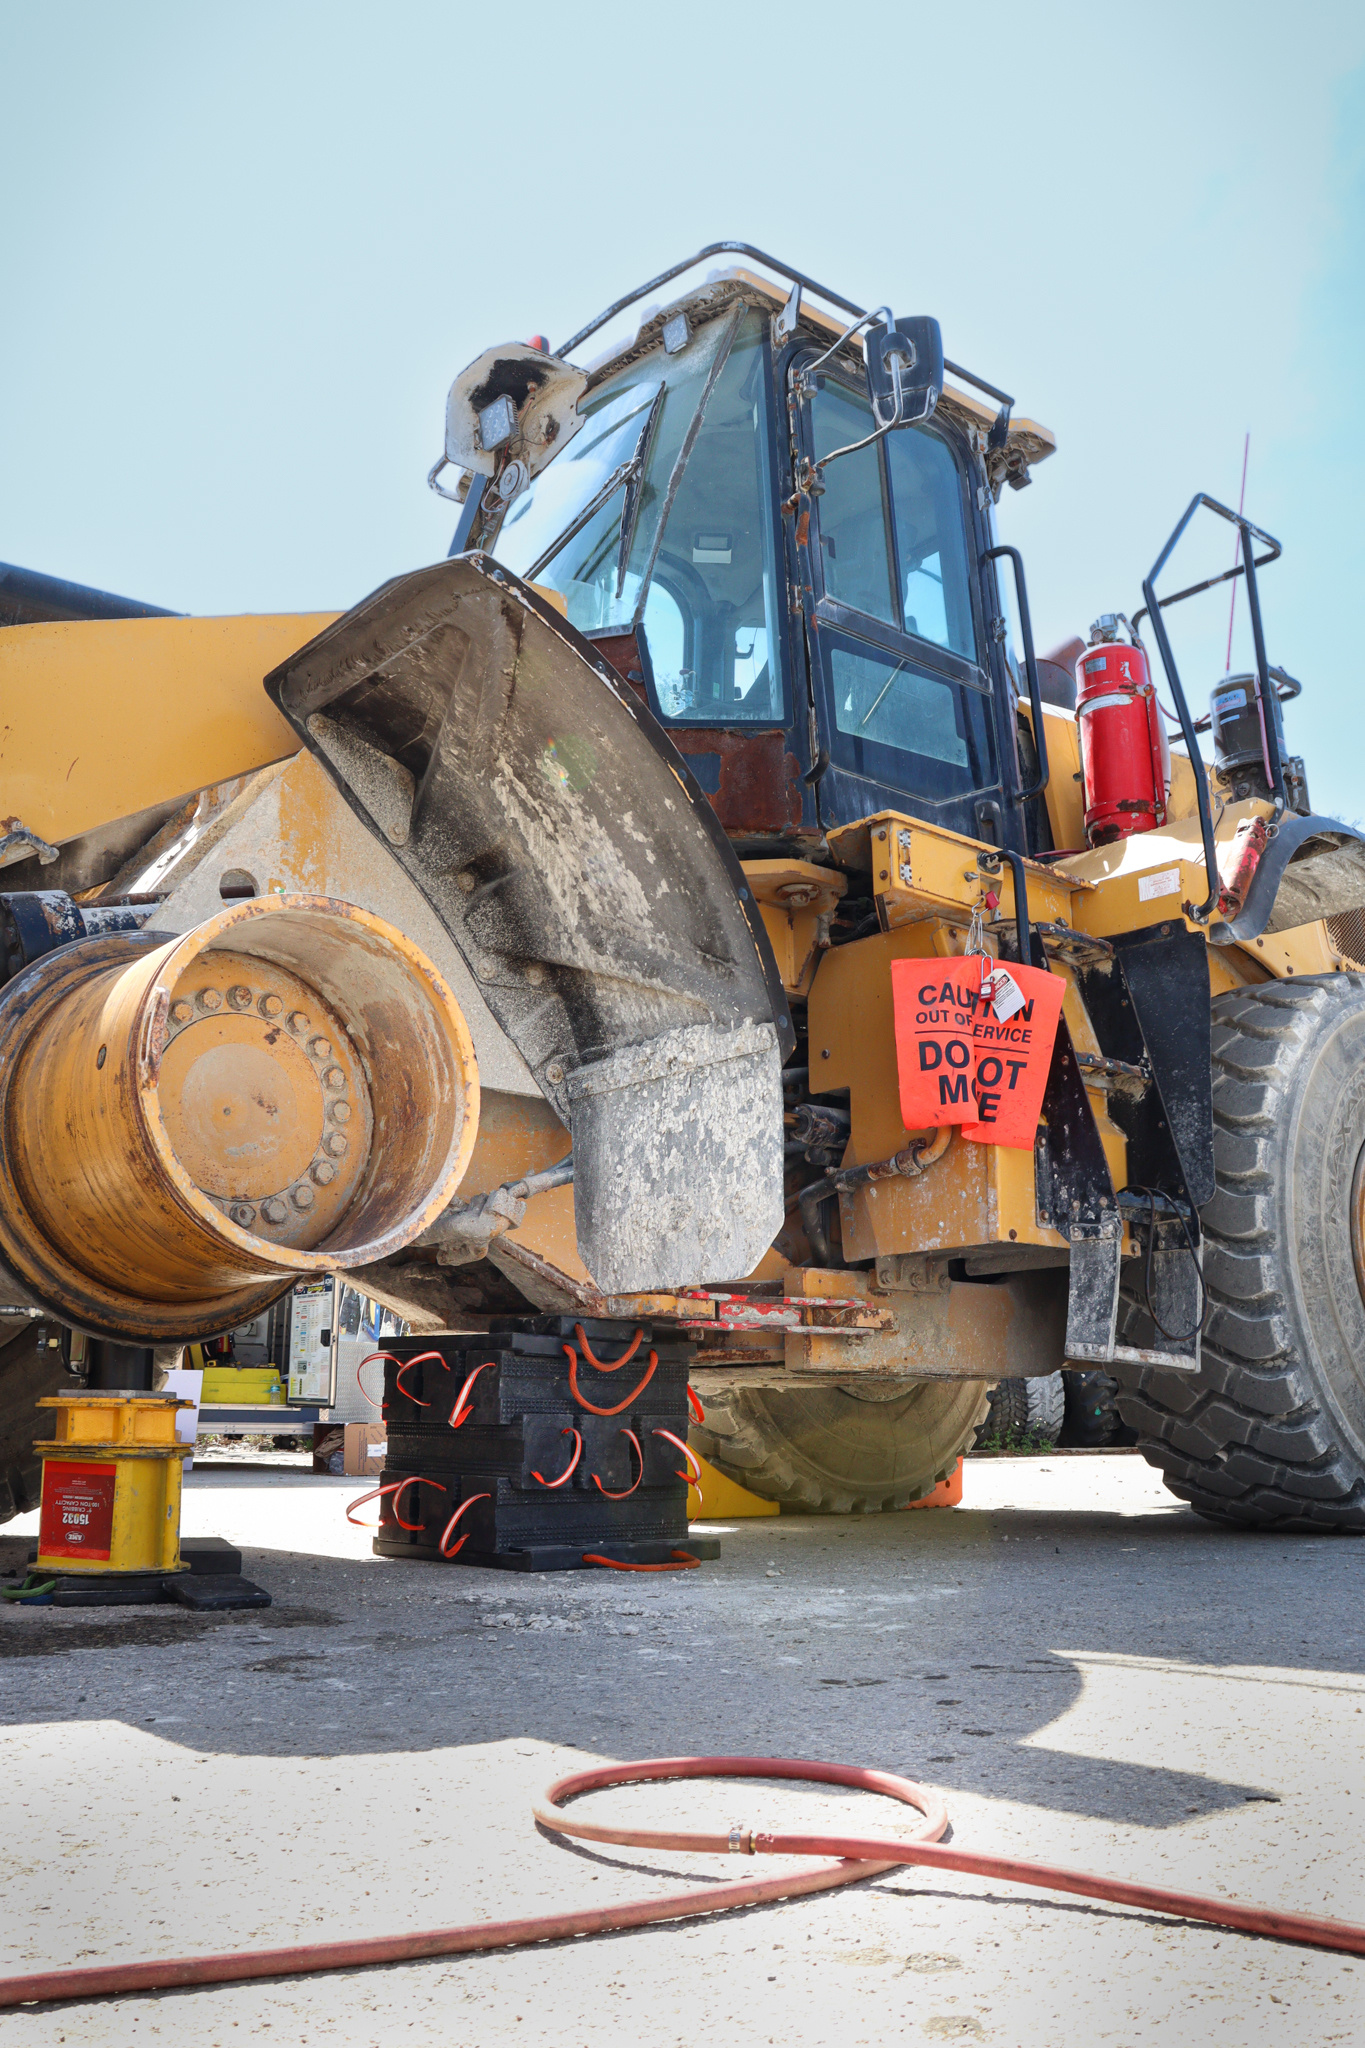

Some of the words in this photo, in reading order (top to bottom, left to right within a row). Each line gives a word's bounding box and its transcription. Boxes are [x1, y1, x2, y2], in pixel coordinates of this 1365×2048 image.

[918, 982, 1034, 1022] CAUTIN
[916, 1010, 949, 1024] OUT
[955, 1013, 973, 1027] OF
[973, 1024, 1032, 1043] ERVICE
[919, 1040, 970, 1071] DO
[975, 1055, 1028, 1090] OT
[939, 1074, 1001, 1123] ME
[62, 1512, 89, 1525] 15032
